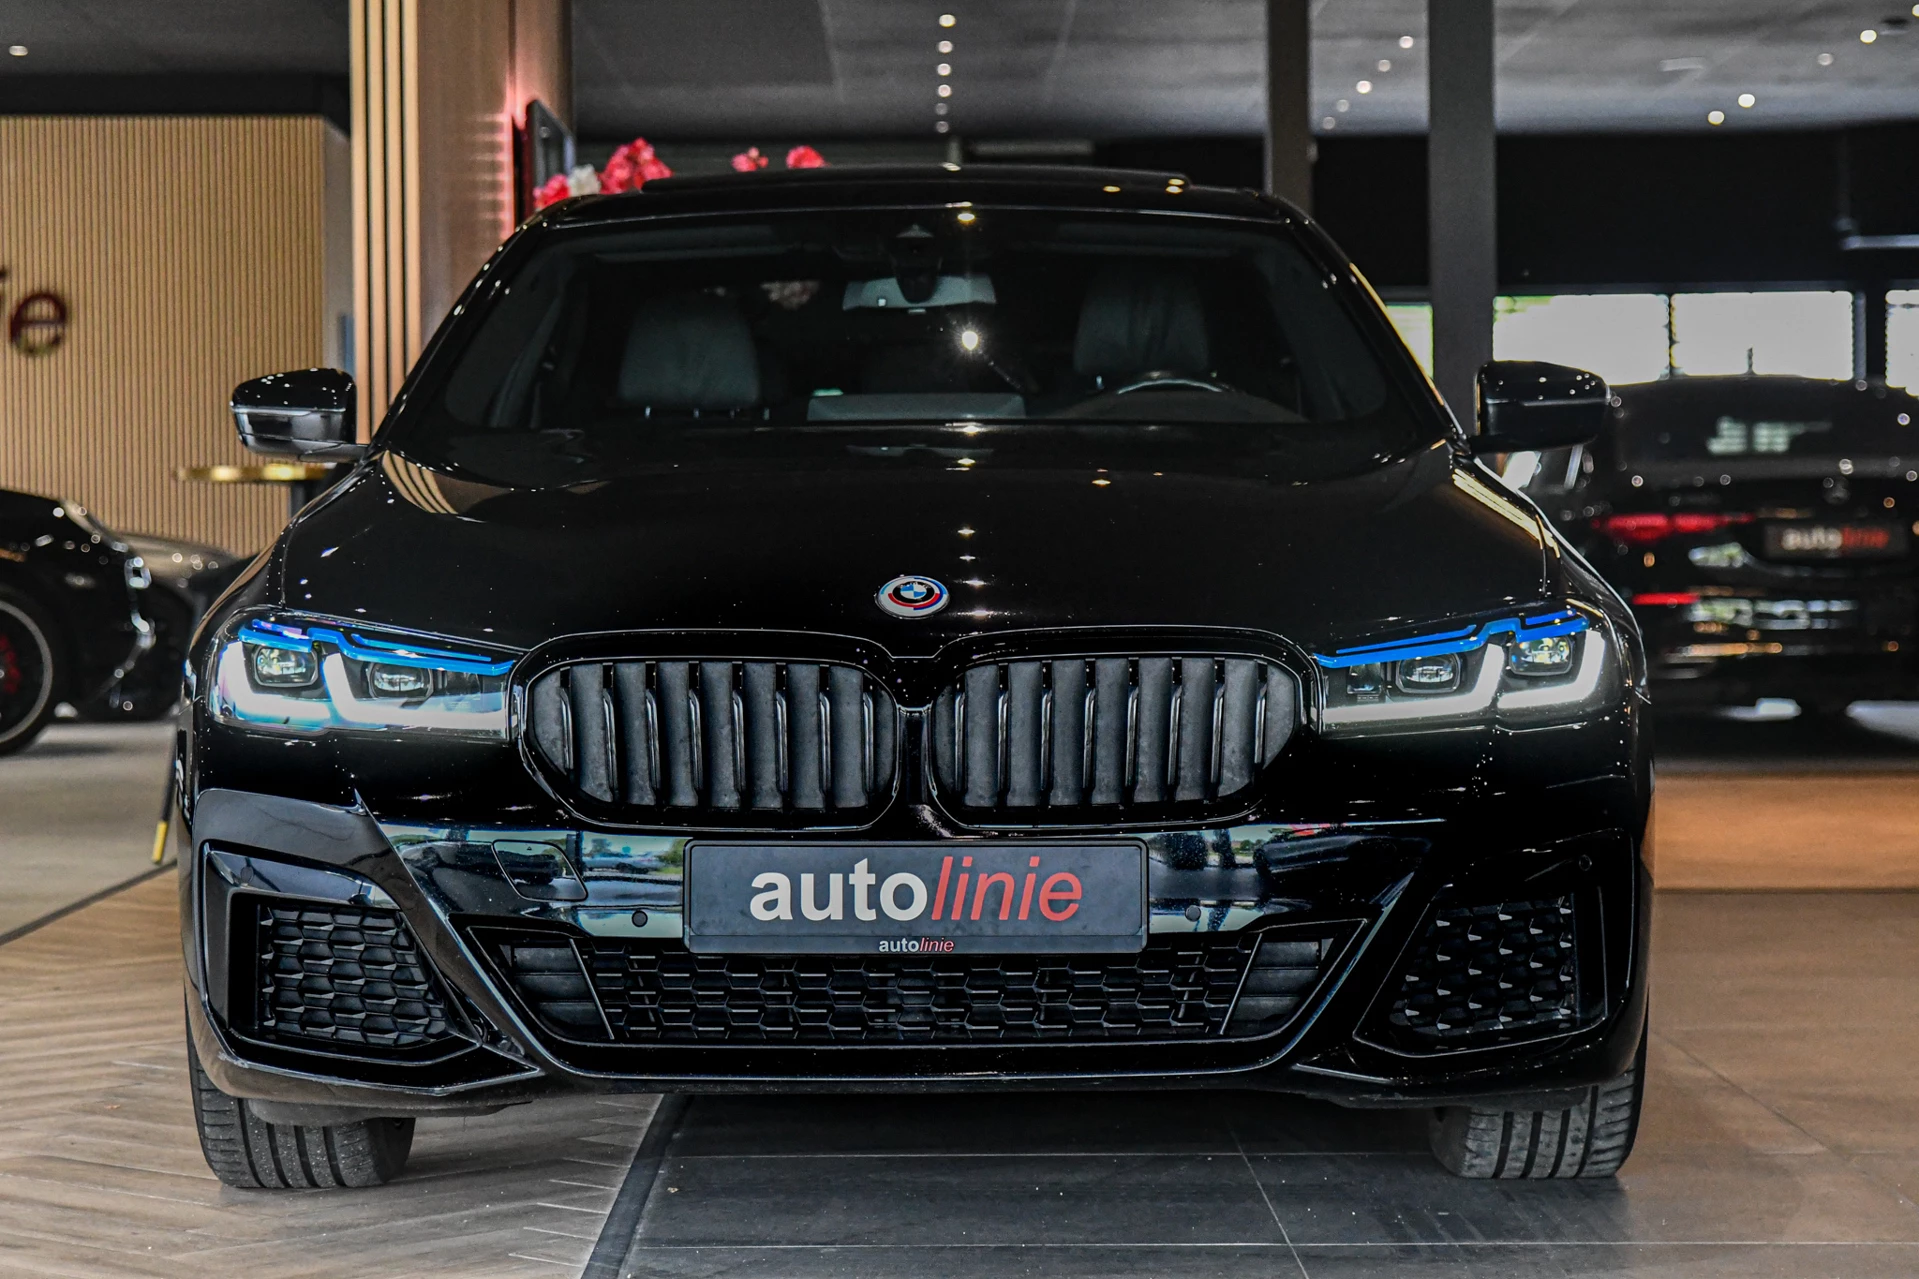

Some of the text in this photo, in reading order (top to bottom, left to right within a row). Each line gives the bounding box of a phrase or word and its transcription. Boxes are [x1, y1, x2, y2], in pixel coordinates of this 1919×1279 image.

[0, 266, 67, 356] e
[750, 856, 1083, 921] autolinie
[879, 937, 954, 952] autolinie
